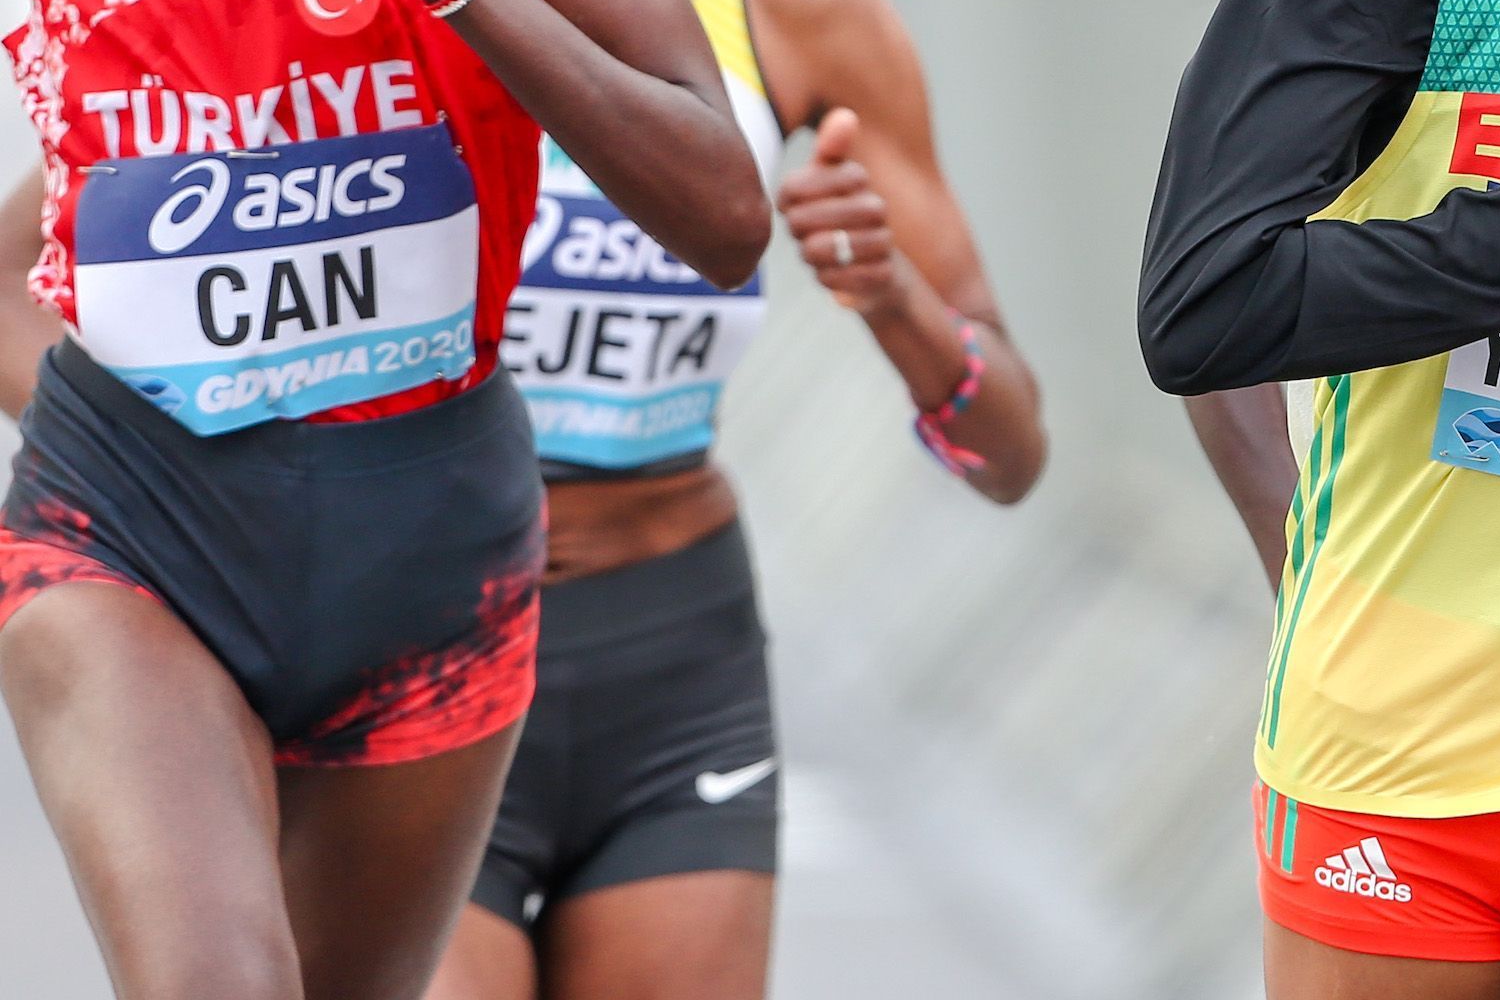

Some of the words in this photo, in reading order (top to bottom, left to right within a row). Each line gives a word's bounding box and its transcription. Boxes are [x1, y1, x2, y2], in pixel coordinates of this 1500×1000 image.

[80, 60, 423, 159] TÜRKİYE
[233, 154, 407, 231] asics
[552, 215, 704, 284] asic
[197, 246, 376, 346] CAN
[194, 345, 368, 415] GDYNIA
[373, 319, 472, 374] 2020
[1314, 866, 1412, 902] adidas
